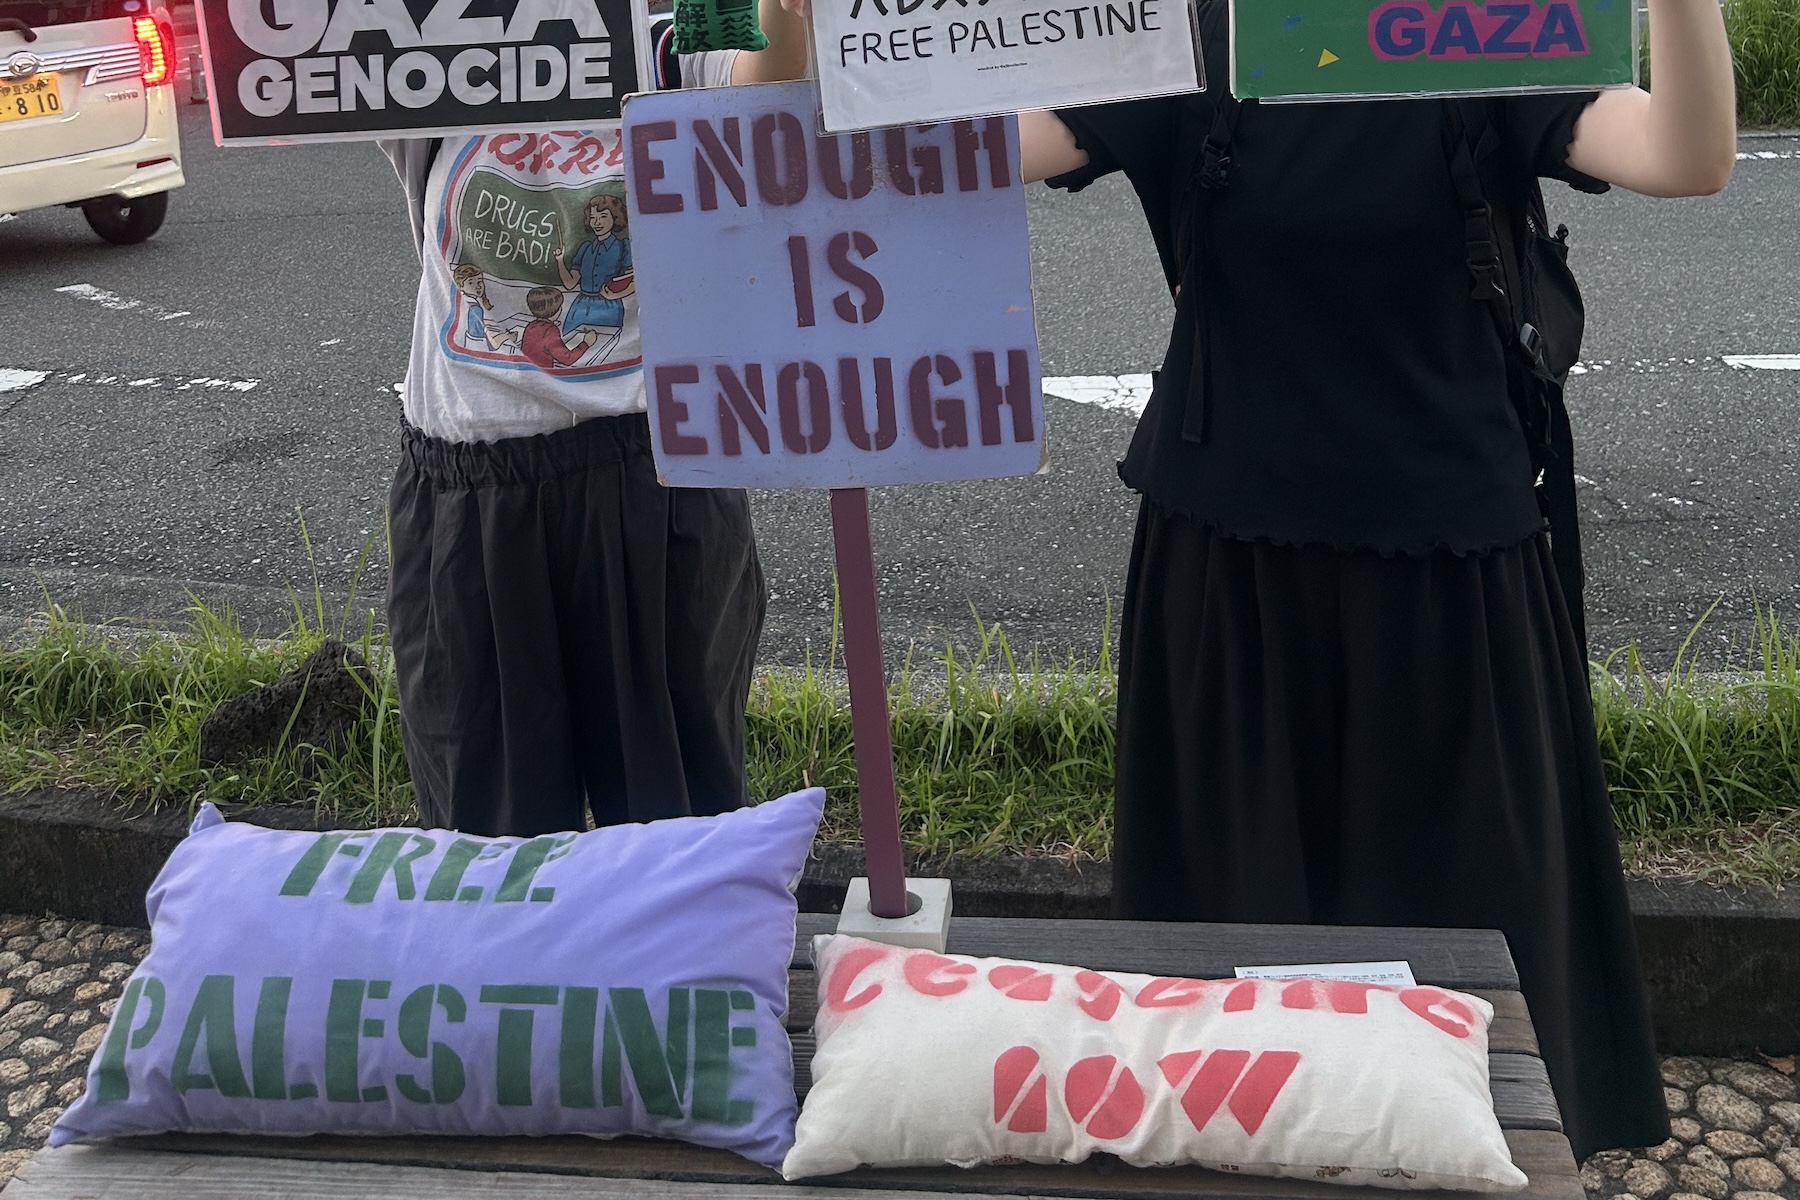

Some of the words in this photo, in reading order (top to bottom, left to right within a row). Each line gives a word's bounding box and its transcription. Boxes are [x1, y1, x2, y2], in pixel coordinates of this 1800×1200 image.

[839, 25, 934, 68] FREE
[1374, 2, 1589, 57] GAZA
[237, 42, 613, 118] GENOCIDE
[631, 111, 1011, 215] ENOUGH
[465, 227, 494, 250] ARE
[495, 230, 551, 269] BAD!
[474, 189, 557, 238] DRUGS
[787, 230, 886, 328] IS
[653, 349, 1036, 457] ENOUGH
[278, 830, 578, 905] FREE
[95, 973, 758, 1125] PALESTINE
